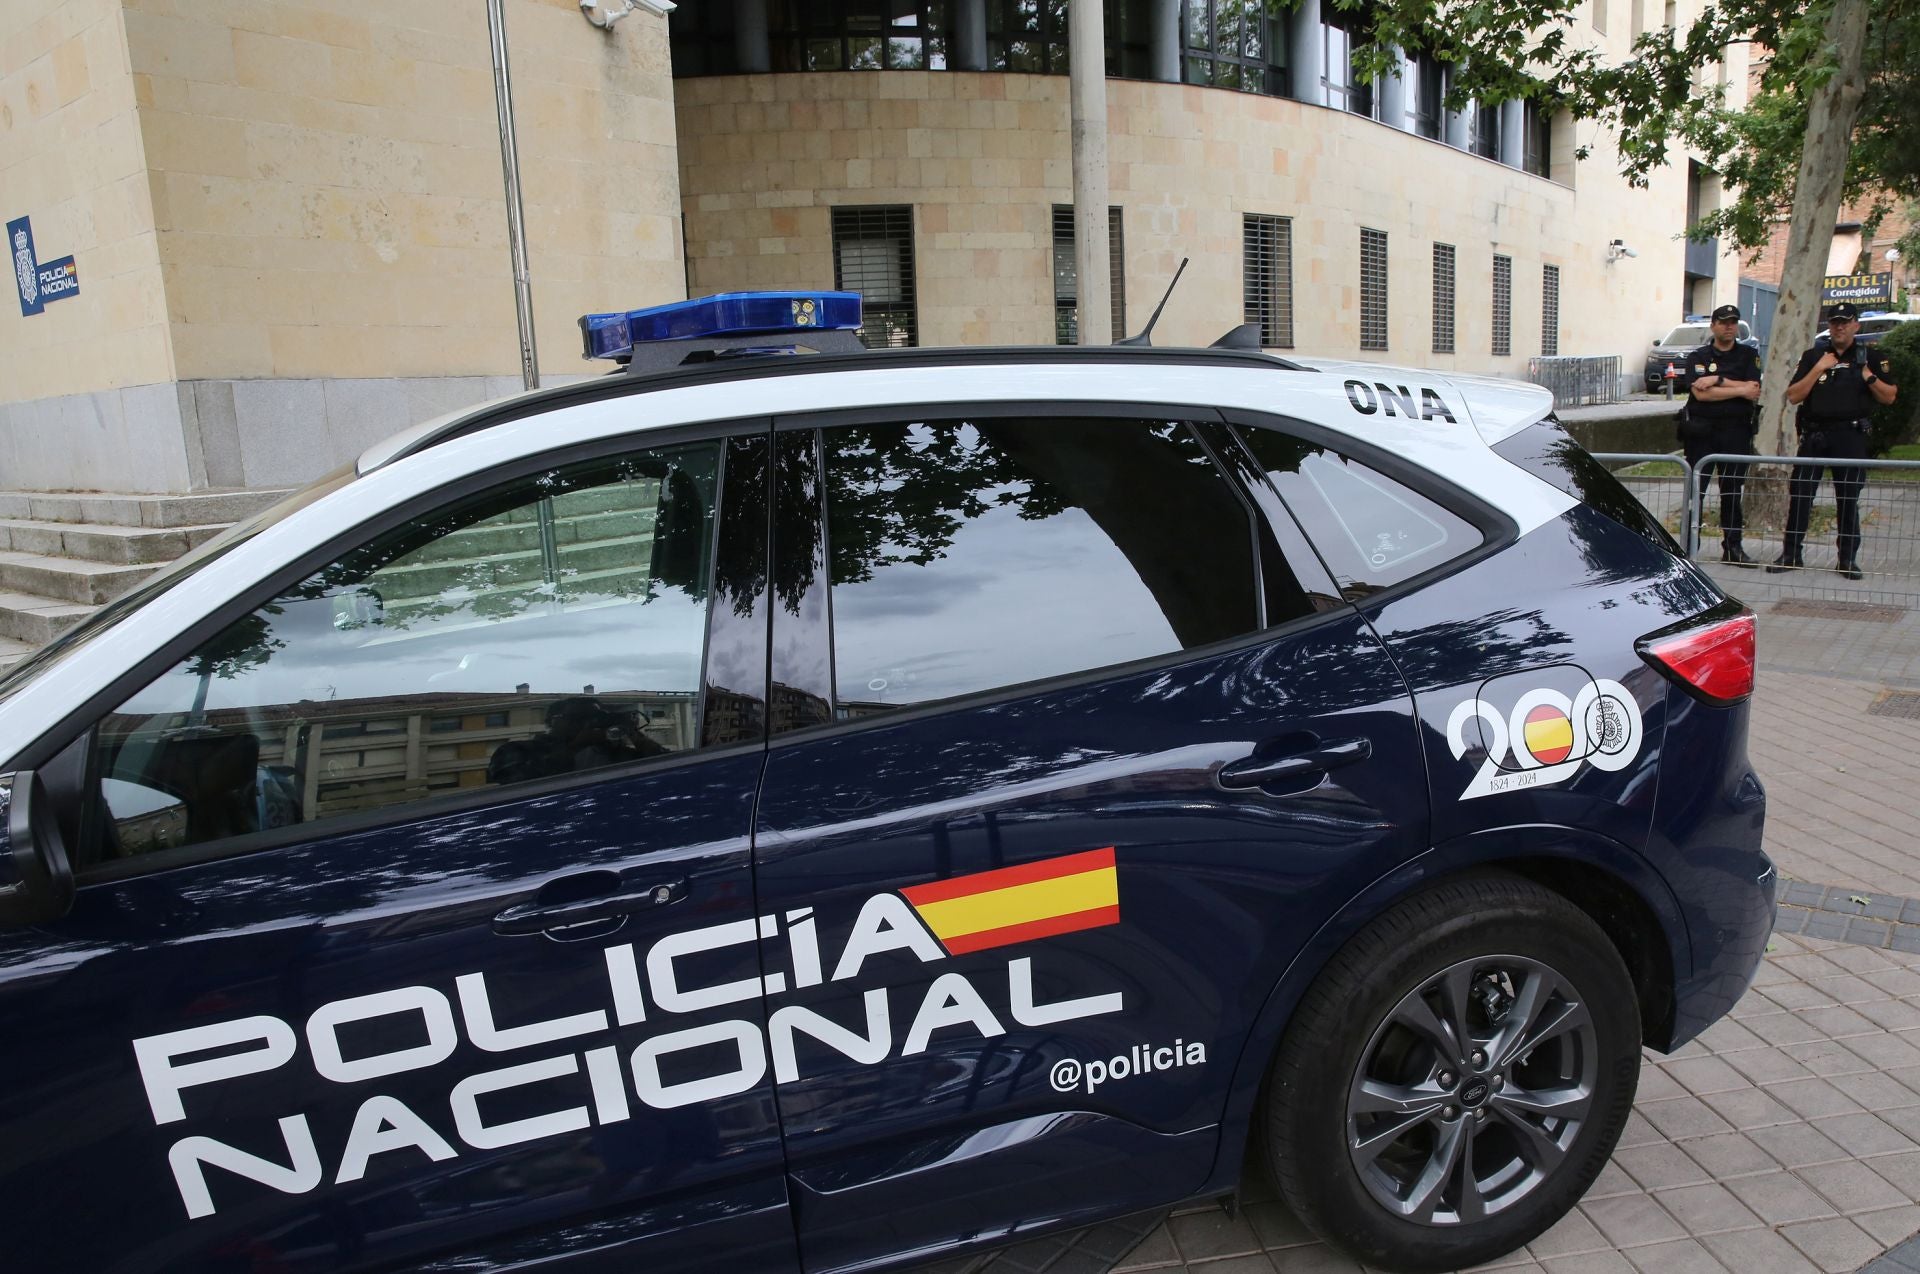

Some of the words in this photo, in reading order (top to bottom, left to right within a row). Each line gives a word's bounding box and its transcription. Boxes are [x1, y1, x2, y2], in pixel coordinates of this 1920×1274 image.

[41, 277, 77, 295] NACIONAL
[1830, 287, 1880, 297] Corregidor
[1343, 379, 1458, 424] ONA
[1446, 679, 1643, 801] 200
[1490, 777, 1509, 791] 1824
[1517, 772, 1537, 786] 2024
[168, 956, 1123, 1220] NACIONAL
[1050, 1038, 1207, 1095] @policia
